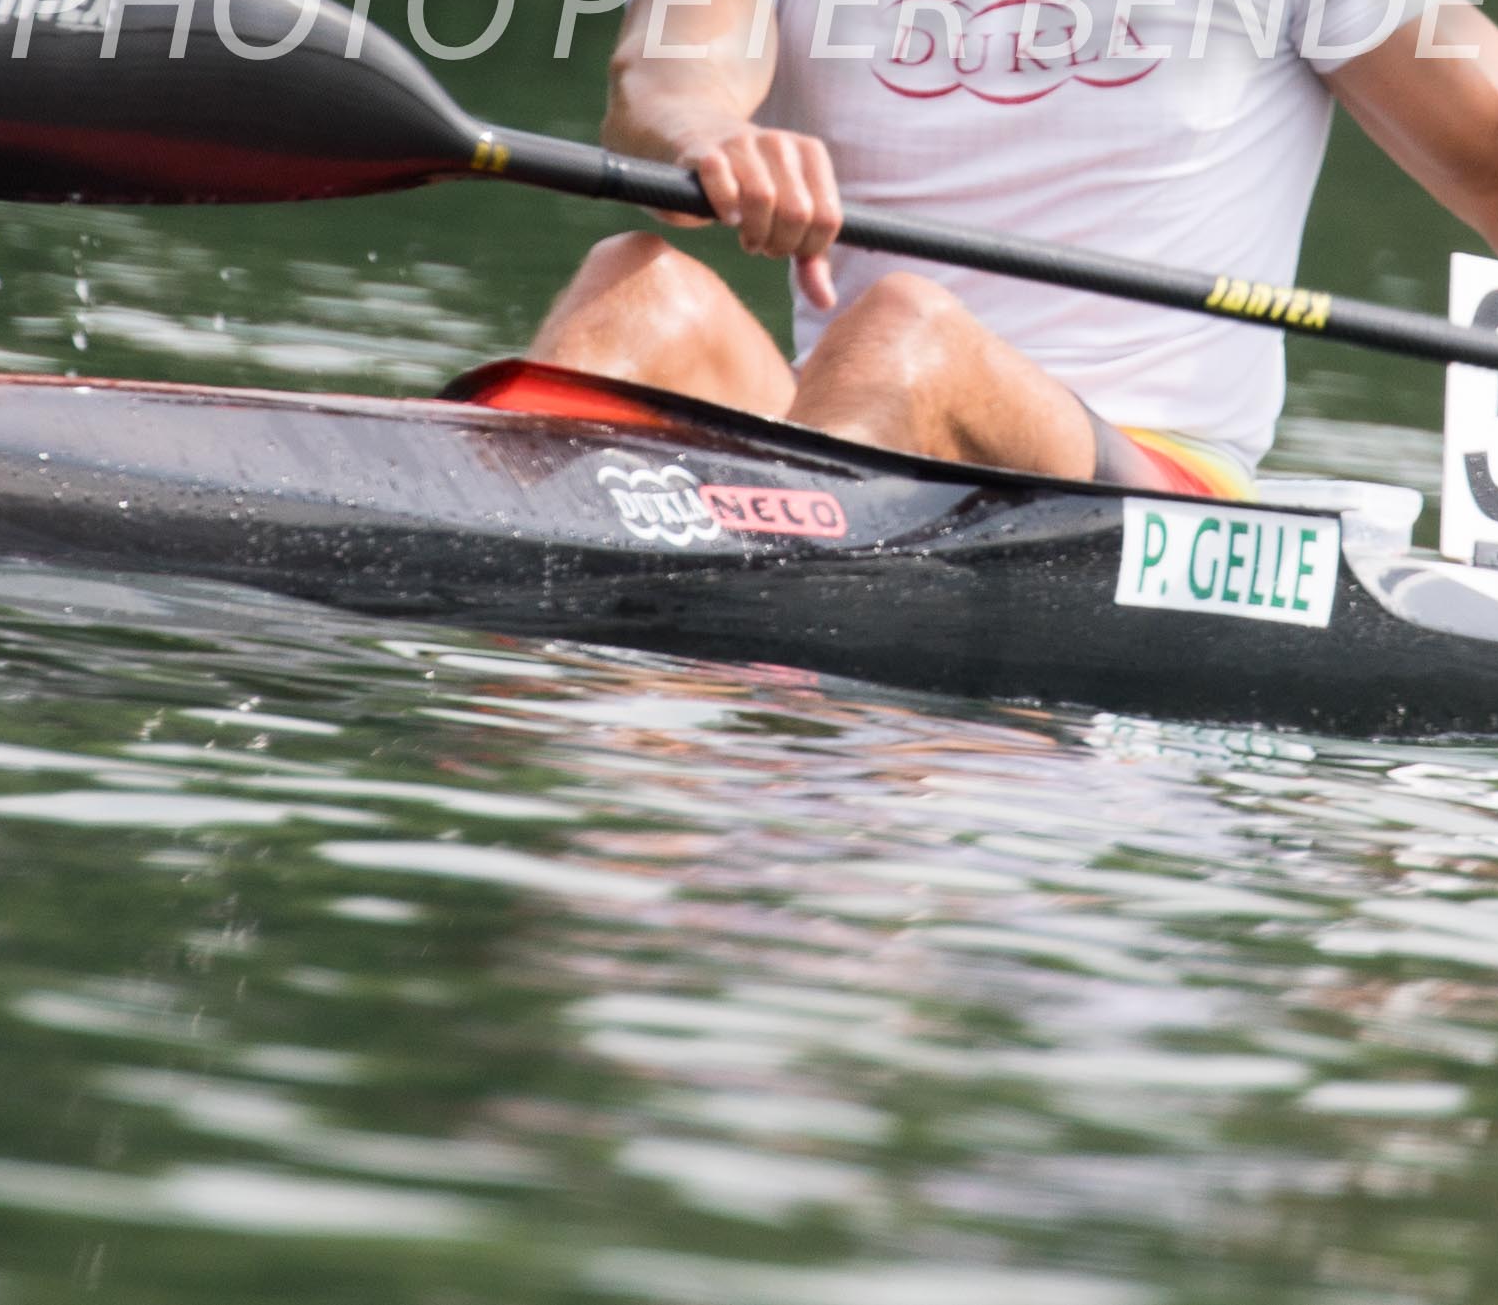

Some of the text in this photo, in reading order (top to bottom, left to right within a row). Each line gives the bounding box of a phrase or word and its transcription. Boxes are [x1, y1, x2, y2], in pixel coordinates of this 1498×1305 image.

[887, 15, 1148, 75] DUKLA
[1205, 275, 1332, 329] JANTEX
[709, 494, 838, 528] NELO
[1137, 512, 1319, 612] P. GELLE
